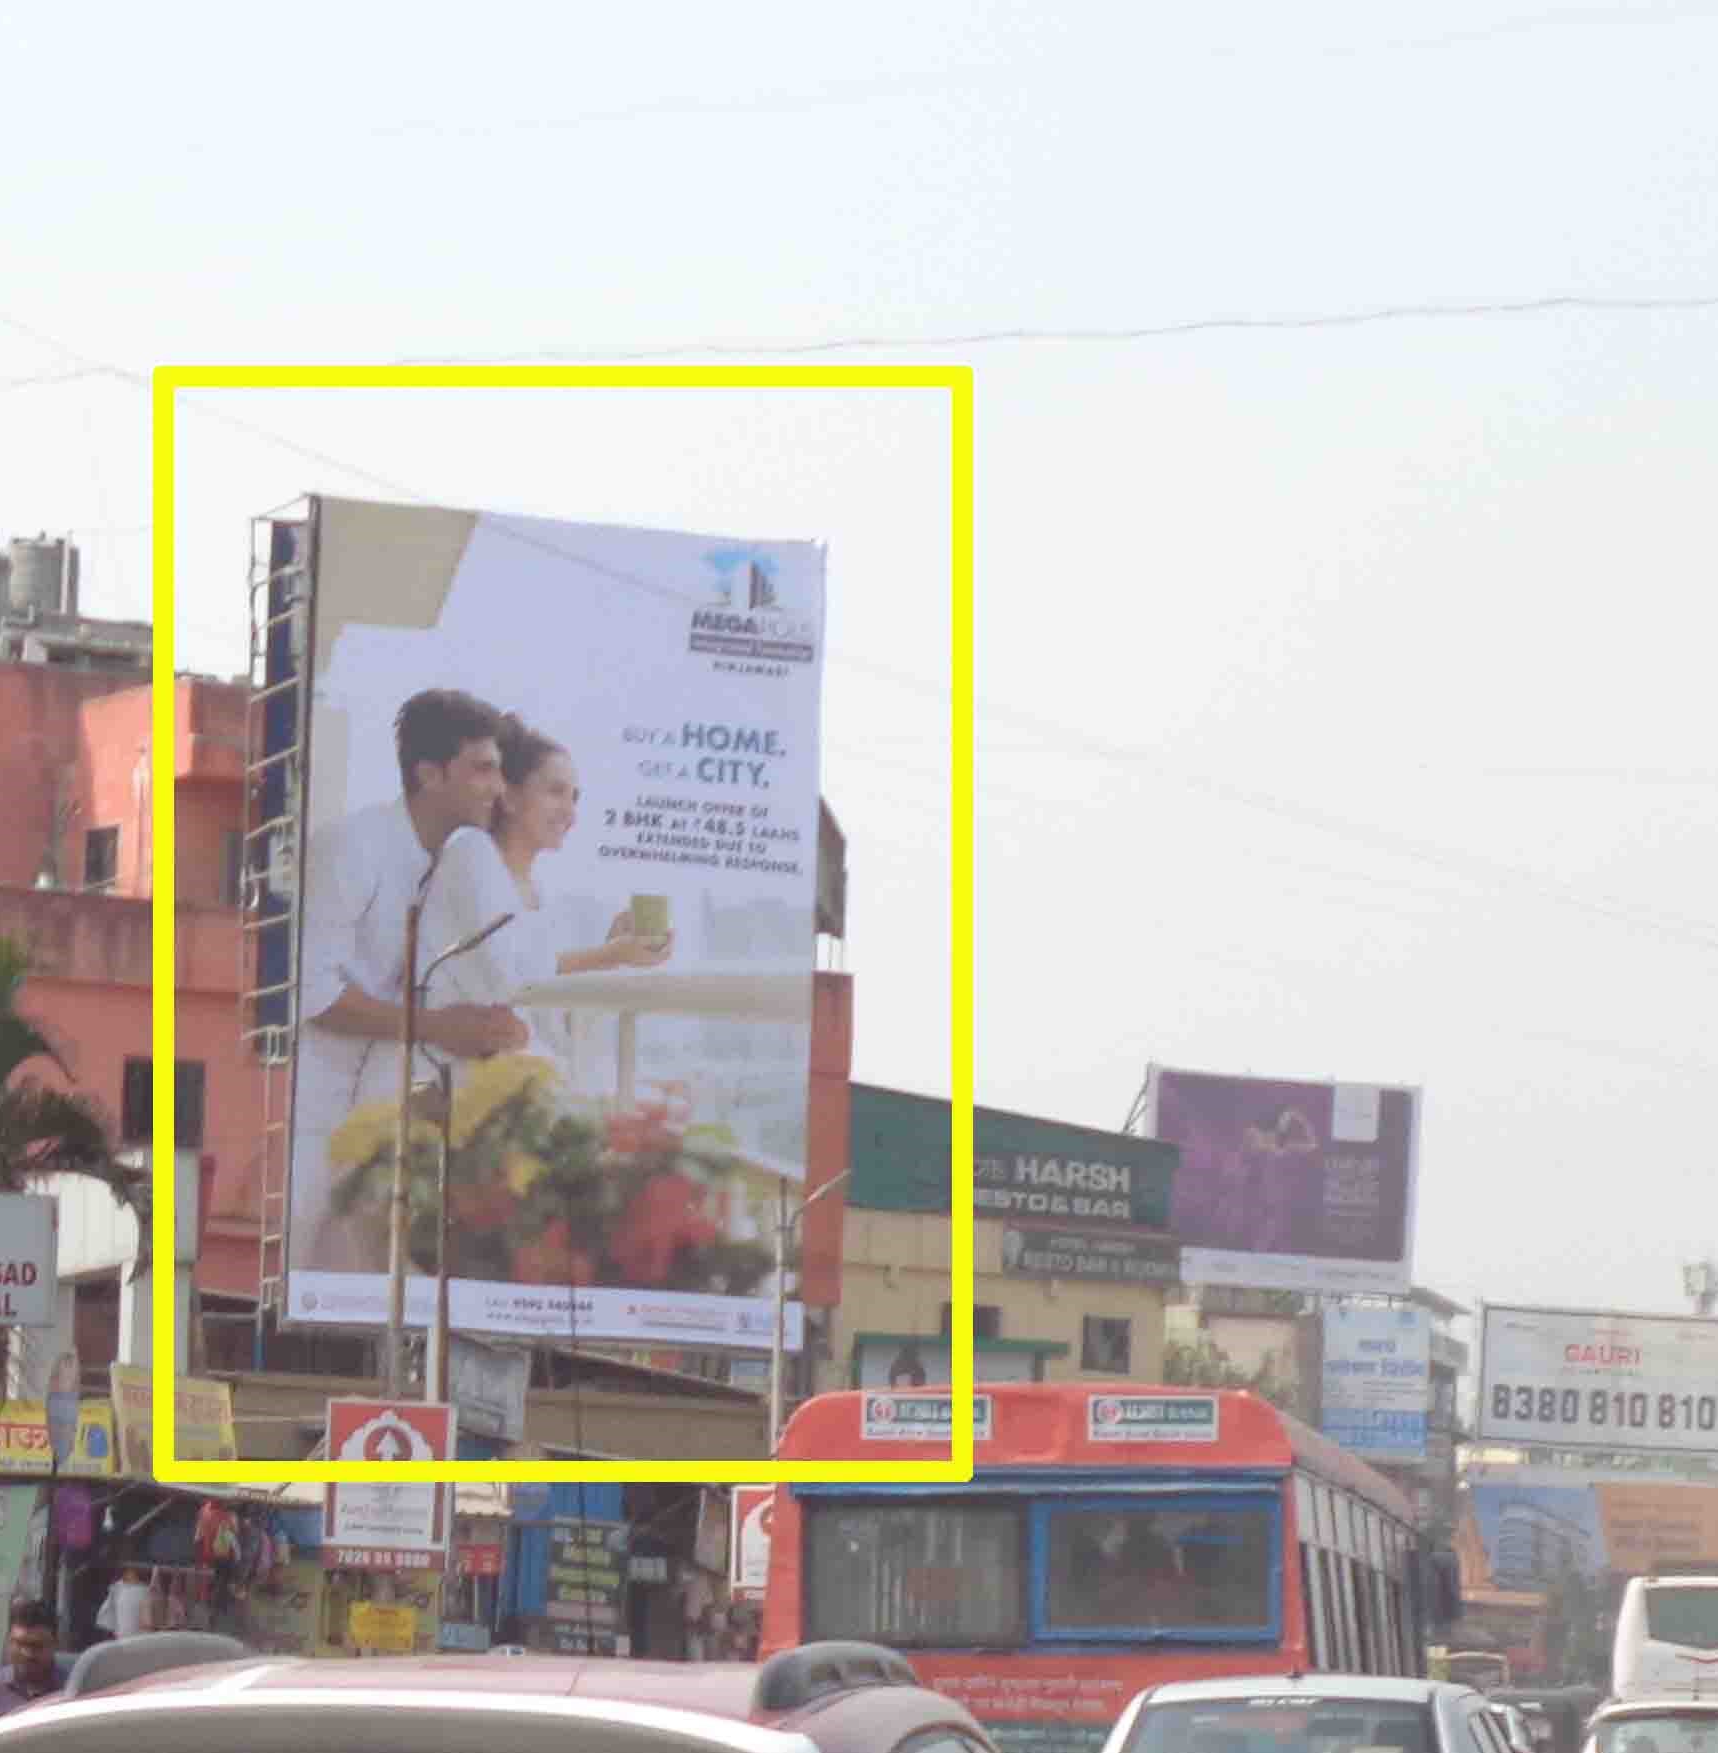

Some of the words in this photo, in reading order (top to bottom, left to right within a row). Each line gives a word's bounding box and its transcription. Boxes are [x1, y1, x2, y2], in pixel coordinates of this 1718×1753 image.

[682, 722, 787, 758] HOME.
[696, 756, 770, 789] CITY.
[605, 808, 616, 826] 2
[623, 811, 663, 831] BHK
[598, 843, 720, 869] OVERWHELMING
[636, 831, 710, 851] EXTENDED
[1015, 1155, 1132, 1194] HARSH
[1490, 1383, 1580, 1424] 8380
[1589, 1389, 1648, 1429] 810
[1658, 1392, 1718, 1431] 810
